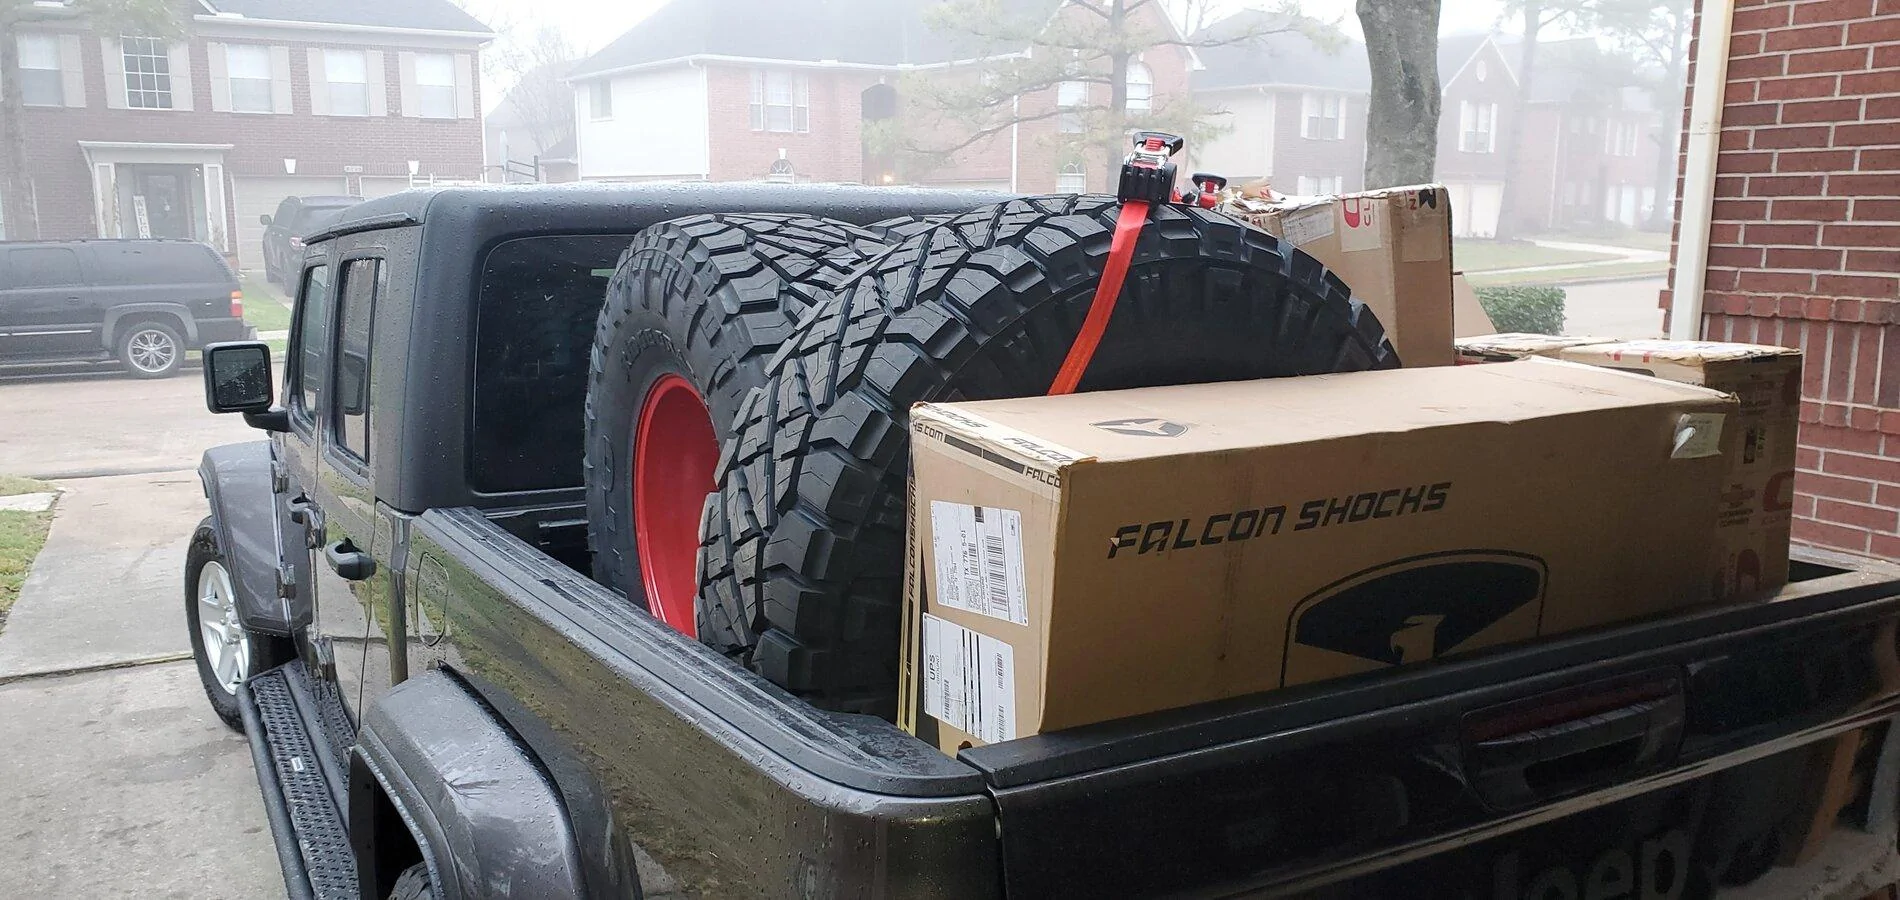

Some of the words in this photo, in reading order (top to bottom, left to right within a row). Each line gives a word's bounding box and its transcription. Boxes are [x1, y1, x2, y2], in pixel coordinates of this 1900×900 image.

[1025, 466, 1062, 489] FALCO
[1107, 505, 1287, 559] FALCON
[964, 567, 970, 576] TX
